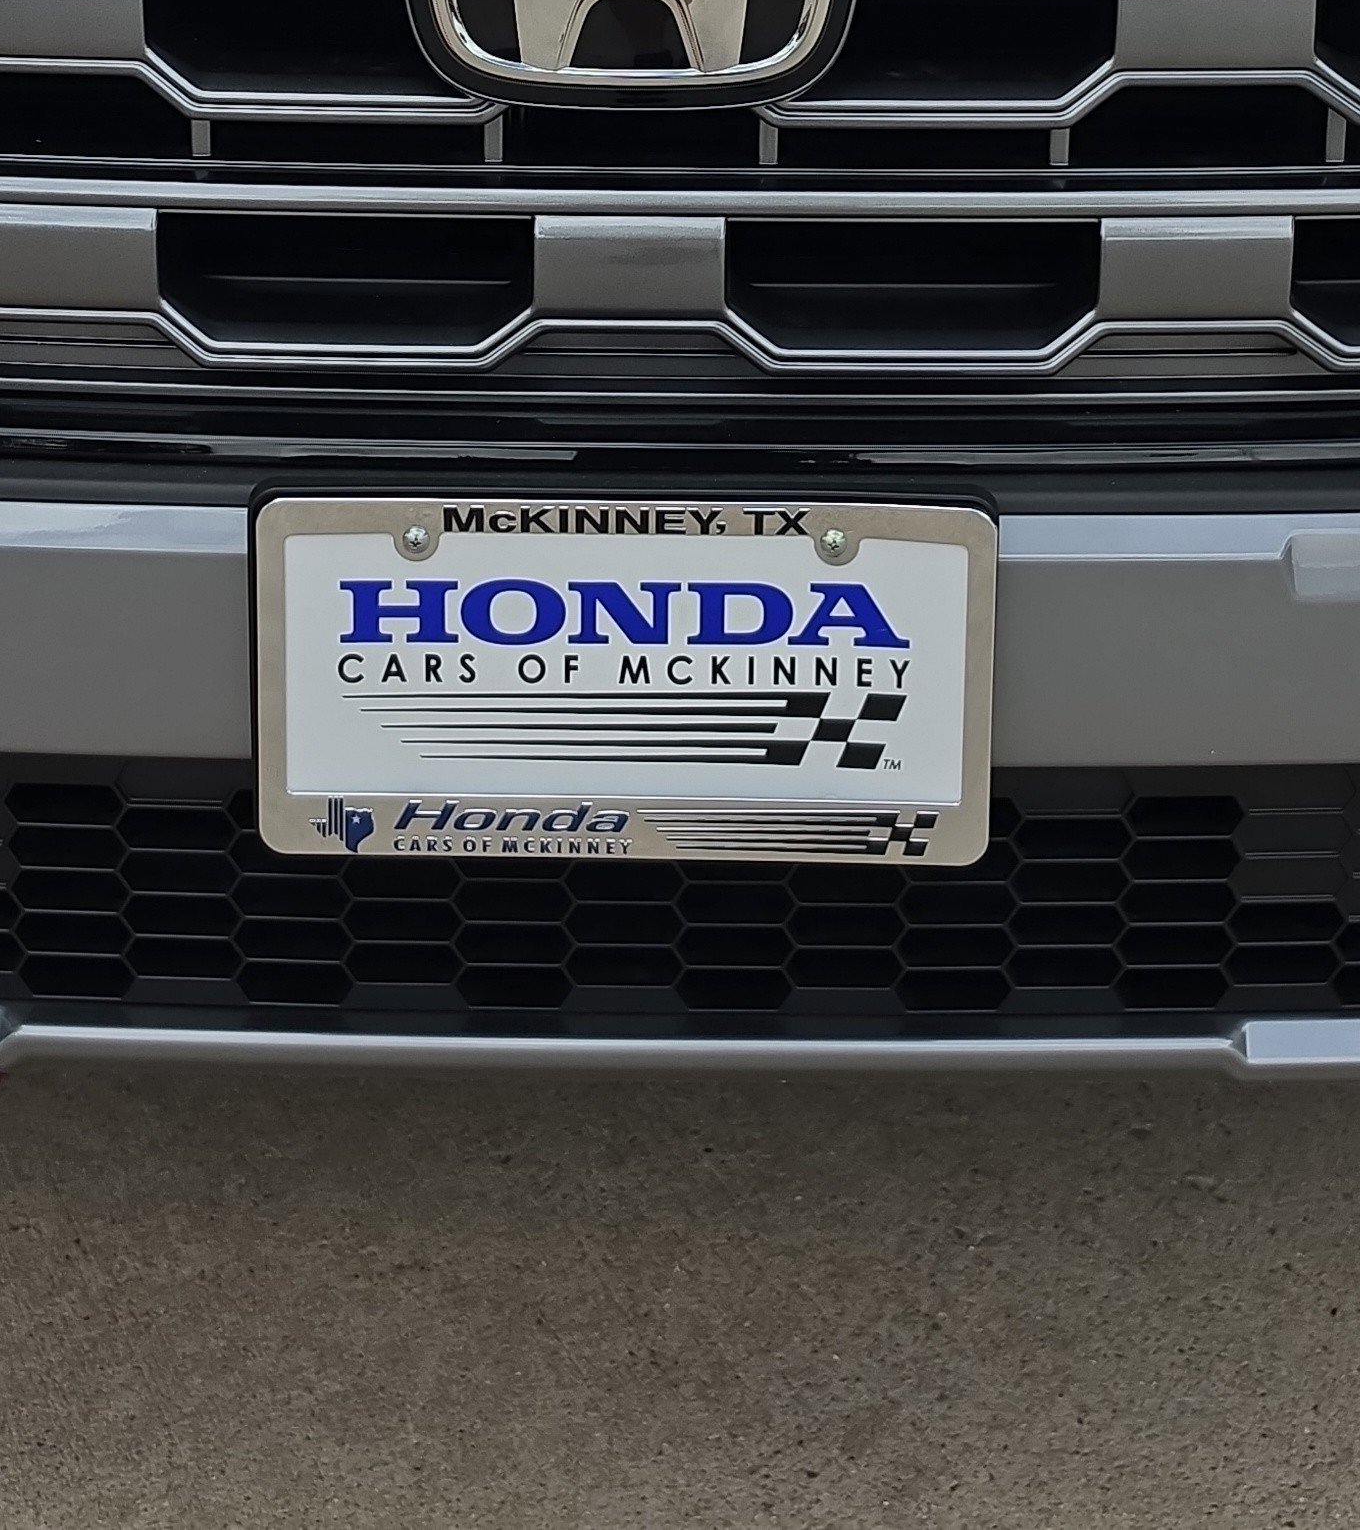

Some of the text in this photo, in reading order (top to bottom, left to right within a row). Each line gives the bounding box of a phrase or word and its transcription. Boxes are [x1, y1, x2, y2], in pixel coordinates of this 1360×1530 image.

[441, 504, 811, 536] McKINNEY, TX
[338, 577, 912, 650] HONDA
[337, 653, 911, 689] CARS OF MCKINNEY
[882, 759, 902, 771] TM
[393, 799, 630, 834] Honda
[393, 835, 633, 855] CARS OF MCKINNEY
